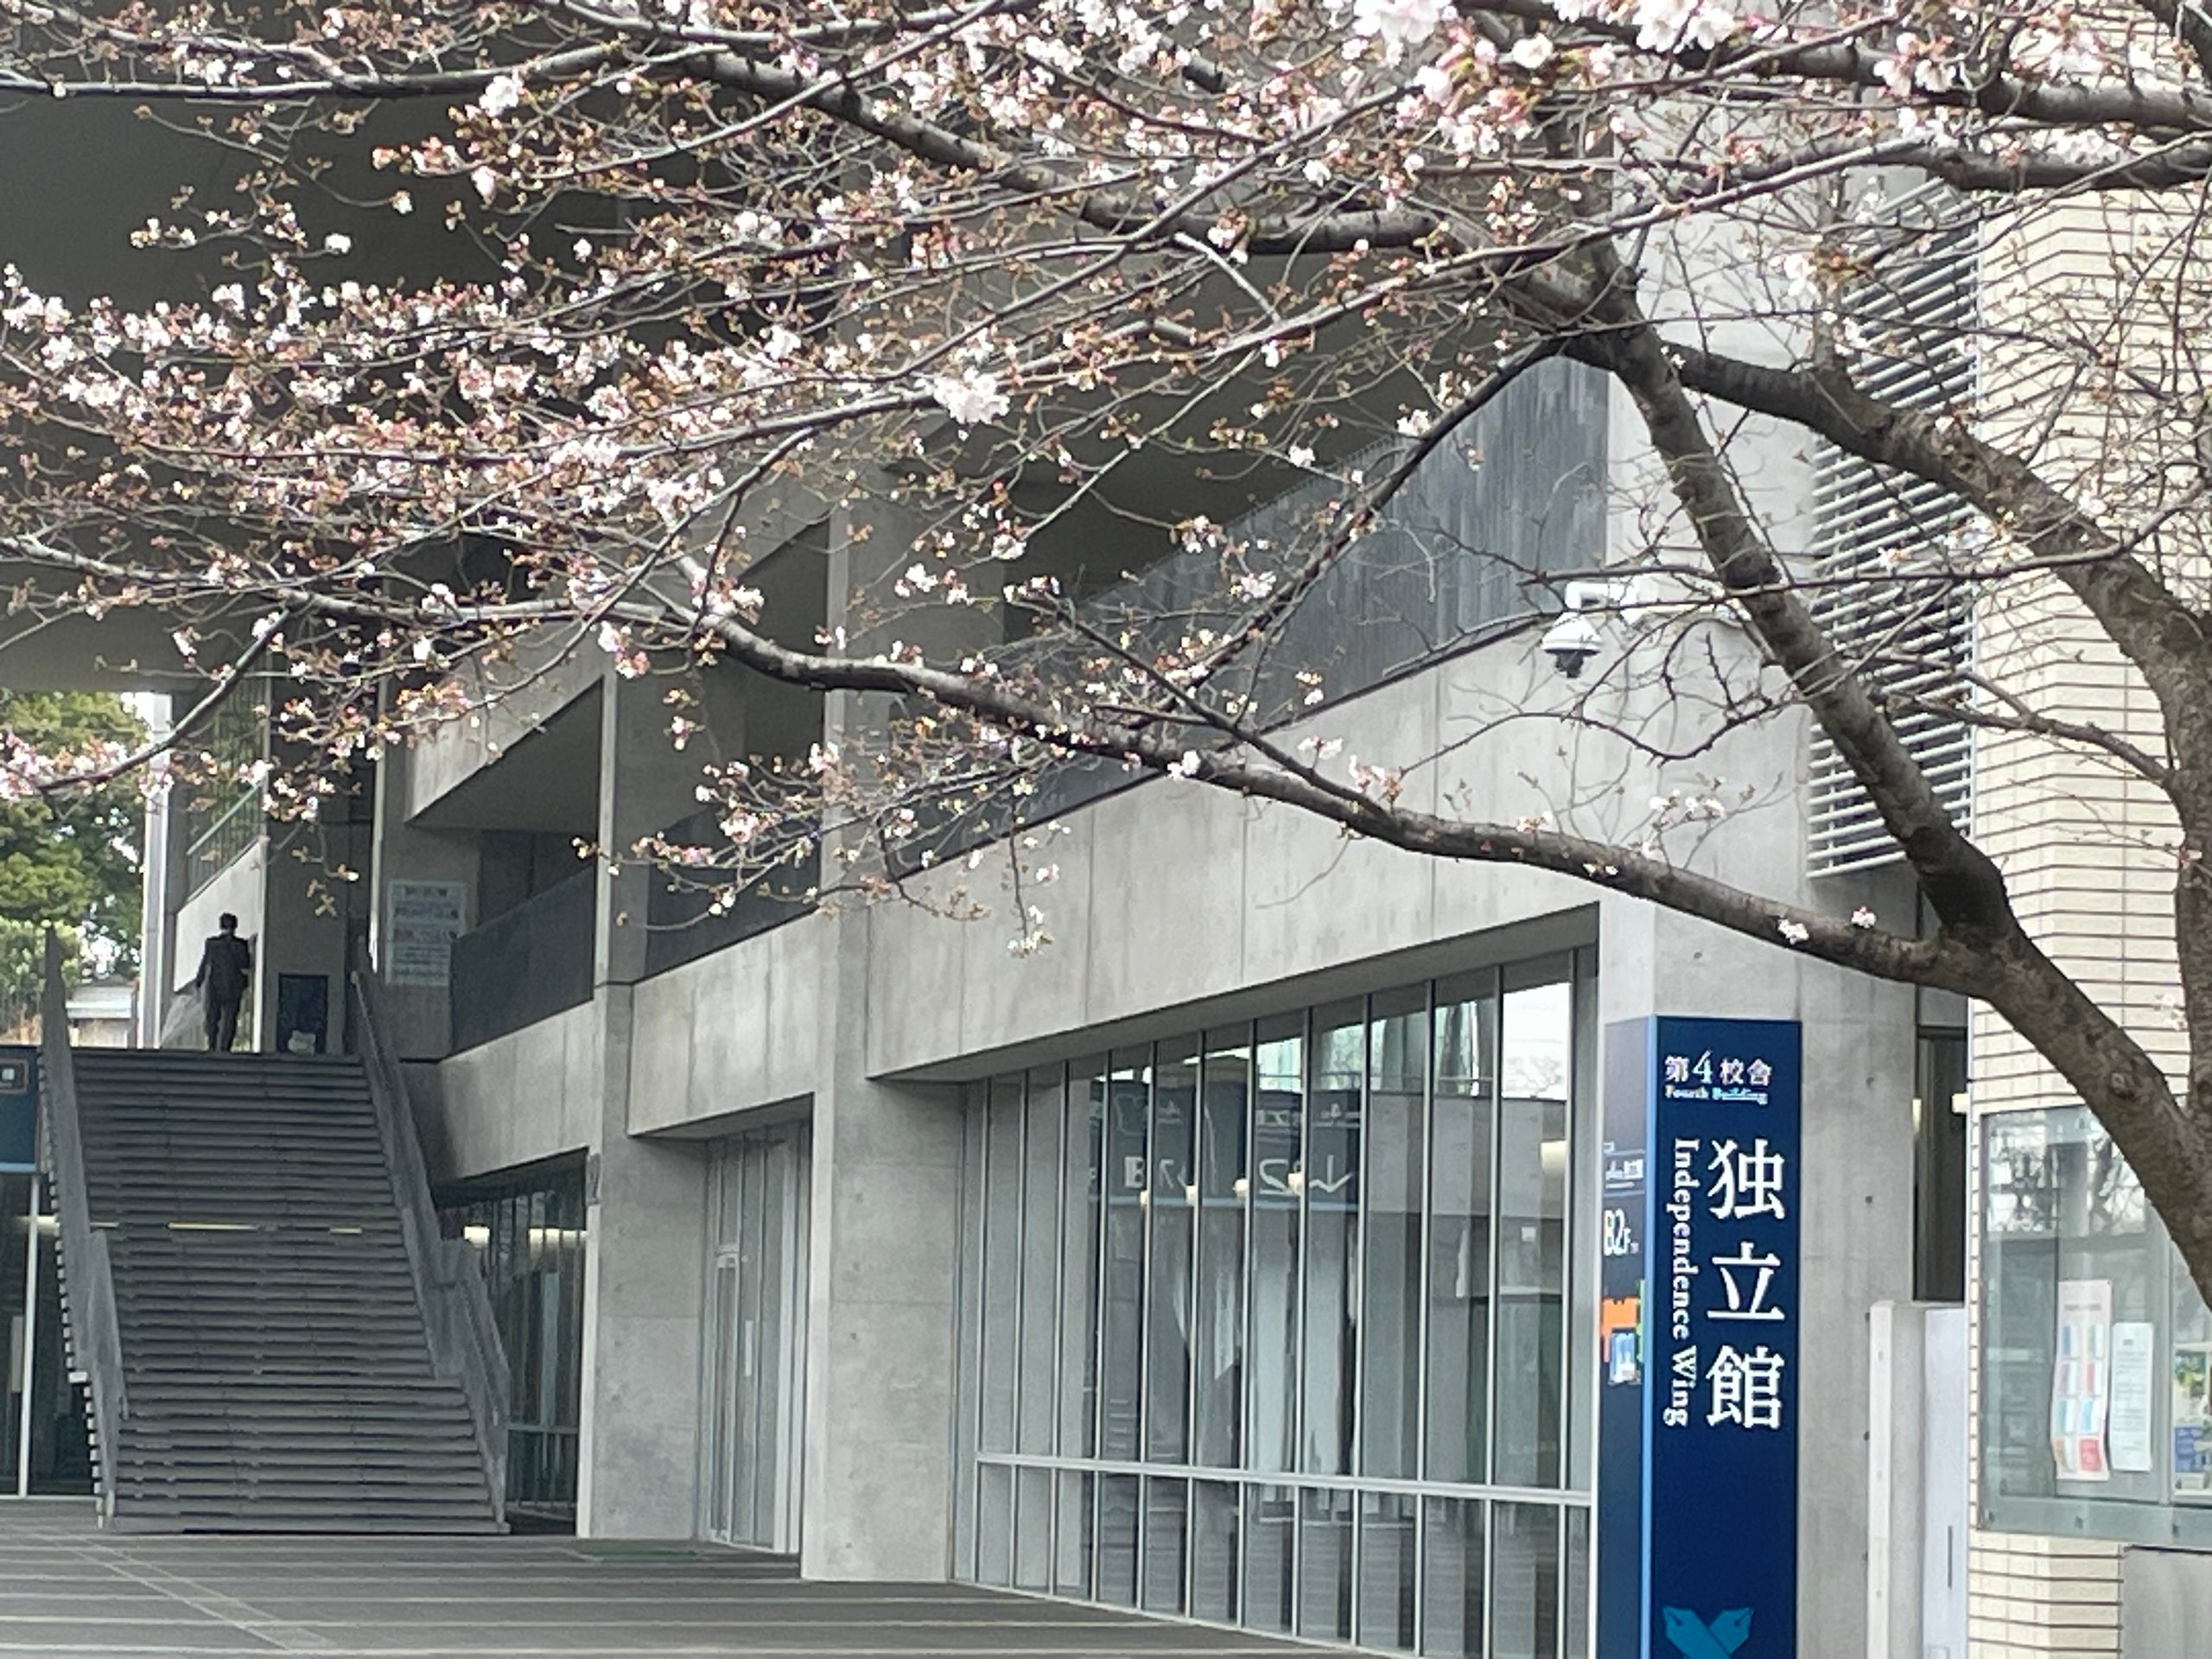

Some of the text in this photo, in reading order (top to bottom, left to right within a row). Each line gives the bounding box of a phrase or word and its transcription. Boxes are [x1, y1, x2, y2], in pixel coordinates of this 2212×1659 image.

[1712, 1086, 1769, 1105] Building
[1662, 1137, 1700, 1427] Independence Wing
[1705, 1137, 1786, 1429] 独立館
